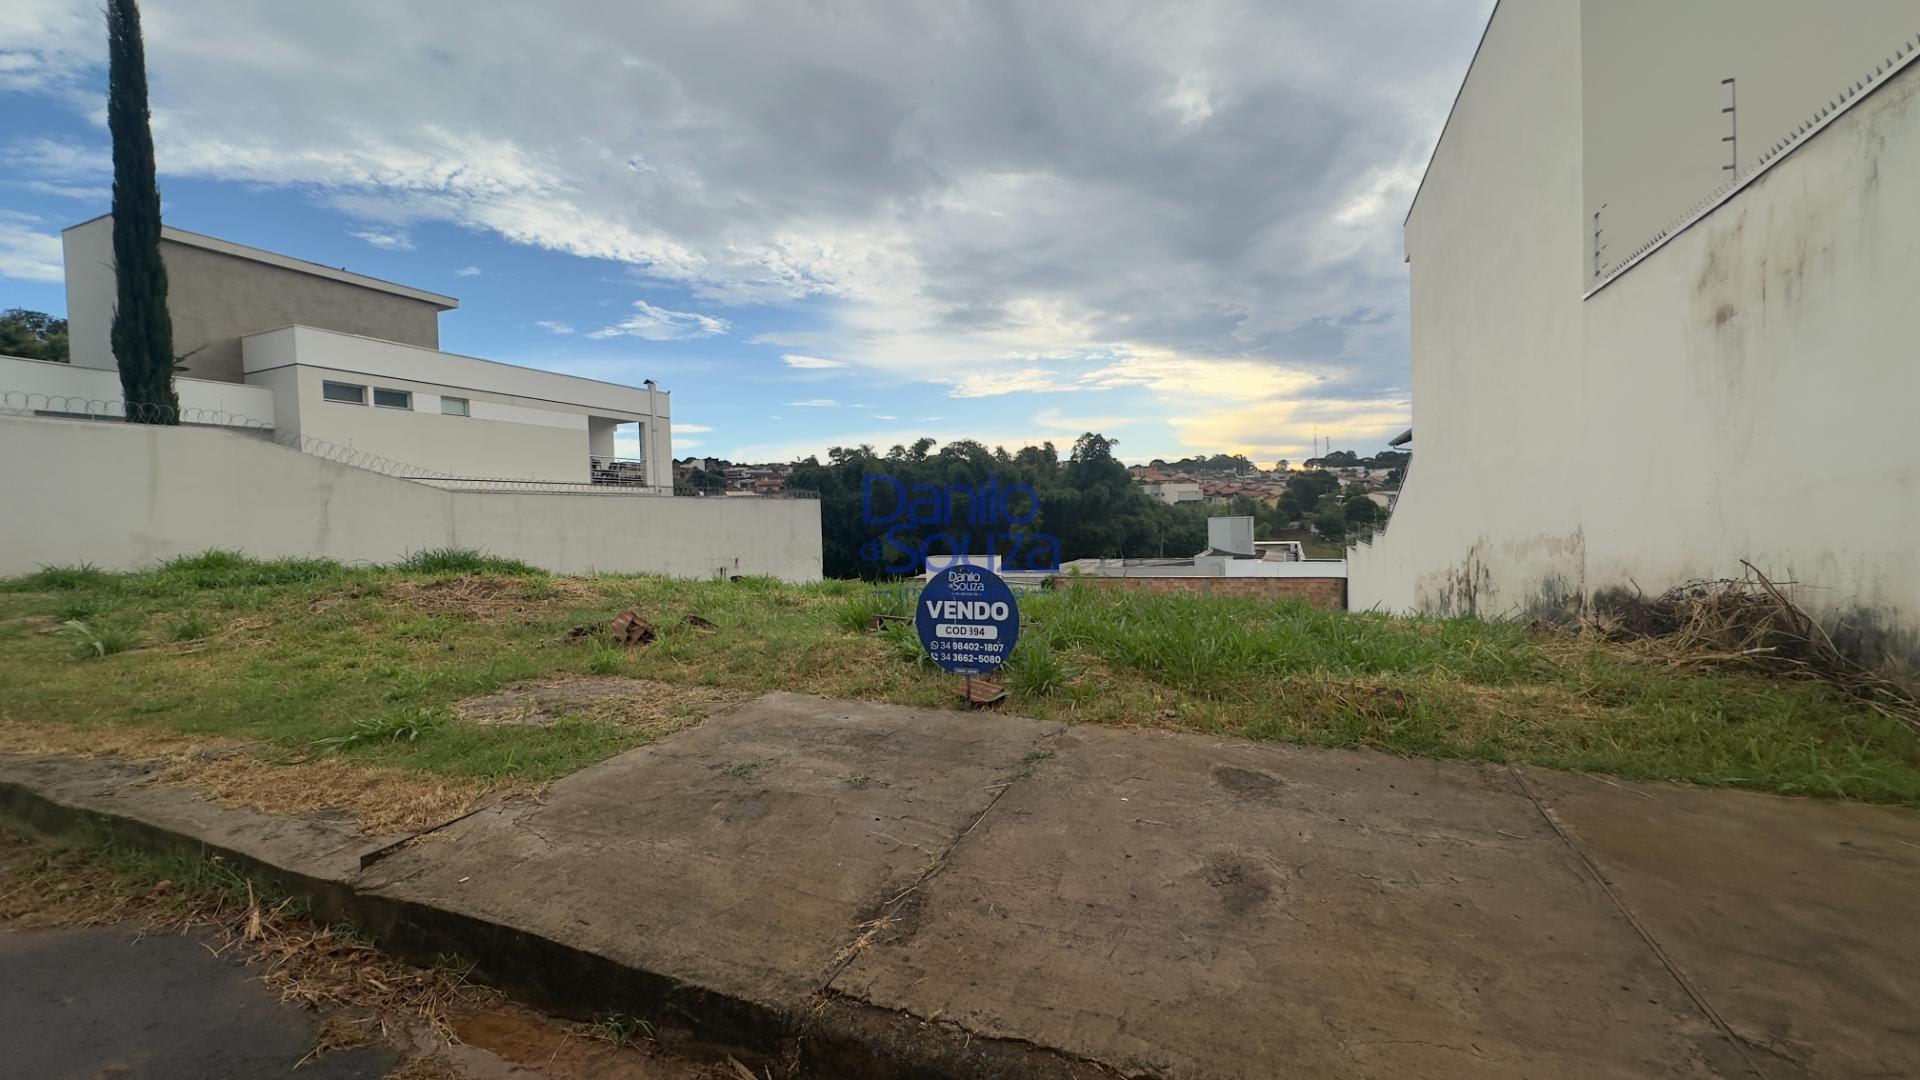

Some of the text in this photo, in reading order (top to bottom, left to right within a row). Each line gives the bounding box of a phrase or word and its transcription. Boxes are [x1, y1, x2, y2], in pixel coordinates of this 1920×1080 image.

[952, 580, 985, 591] Souza
[926, 600, 1009, 621] VENDO
[945, 626, 967, 635] COD
[952, 642, 1004, 652] 98402-1807
[952, 654, 1001, 664] 3662-5080
